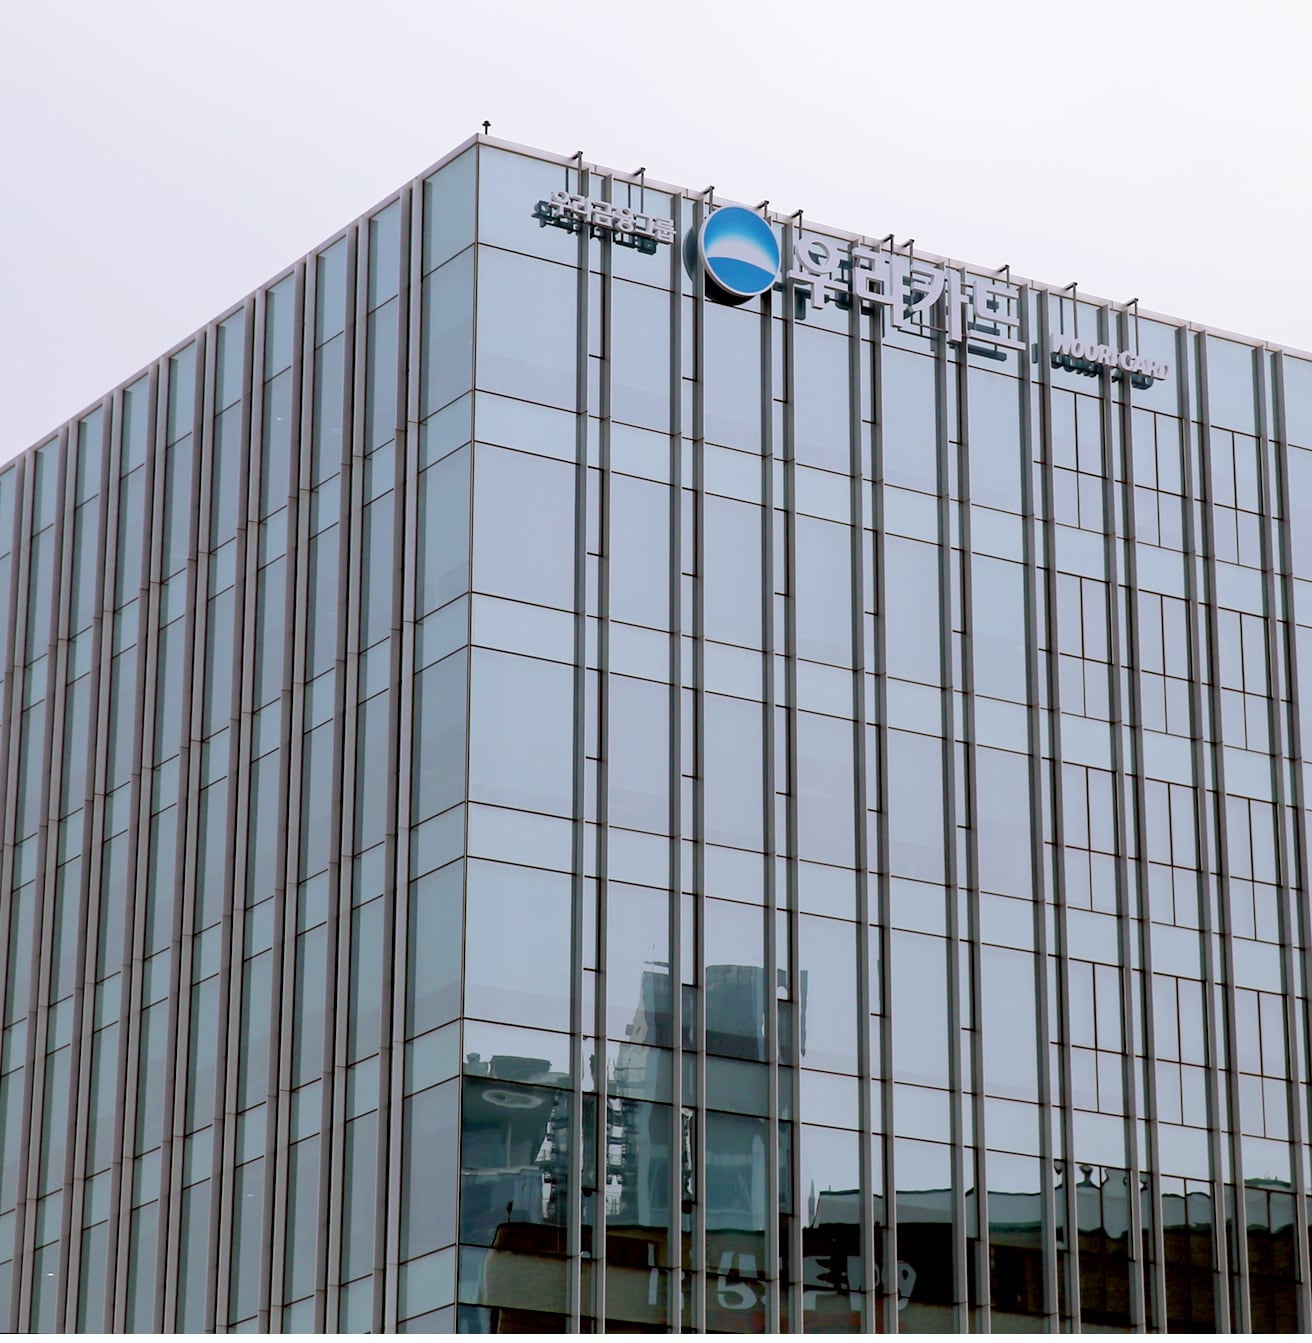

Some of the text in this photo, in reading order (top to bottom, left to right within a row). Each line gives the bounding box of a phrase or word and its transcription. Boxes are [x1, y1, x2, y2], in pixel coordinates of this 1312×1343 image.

[549, 191, 676, 245] 우리금융그룹
[787, 238, 1026, 351] 우리카드
[1119, 350, 1171, 380] CARD
